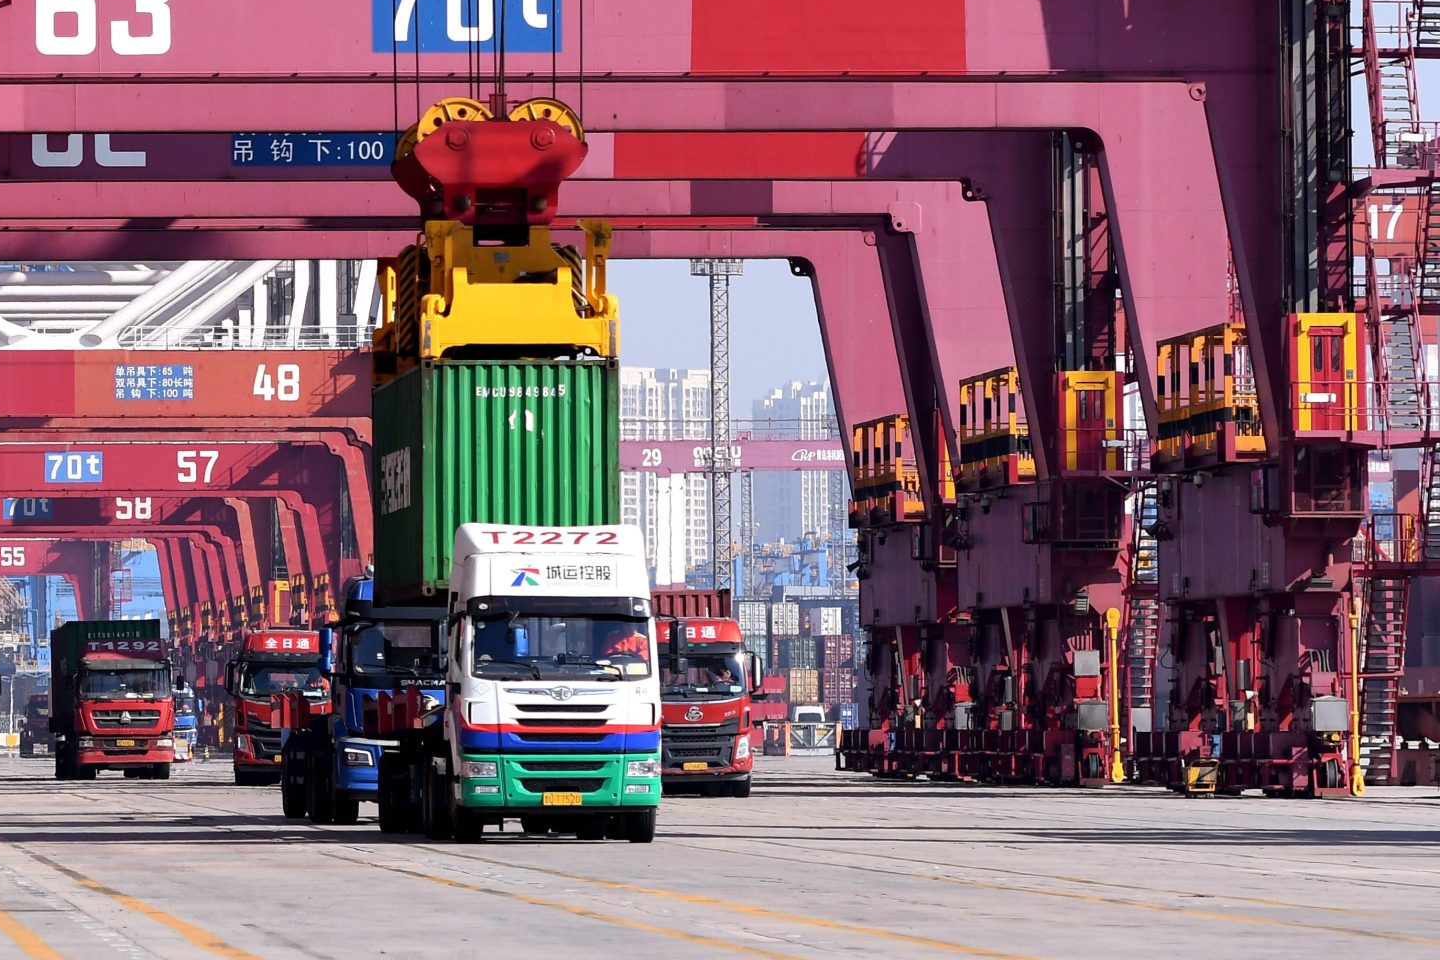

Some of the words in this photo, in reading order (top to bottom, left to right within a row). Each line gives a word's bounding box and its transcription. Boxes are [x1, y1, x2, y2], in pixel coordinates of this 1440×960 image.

[1368, 204, 1403, 239] 17
[253, 364, 300, 401] 48
[48, 454, 99, 480] 70t
[177, 451, 219, 483] 57
[642, 448, 661, 466] 29
[115, 497, 152, 520] 58
[482, 531, 619, 545] T2272
[1, 546, 24, 566] 55
[546, 565, 611, 580] 城运控股
[88, 641, 159, 651] T1292
[265, 637, 310, 649] 全日通
